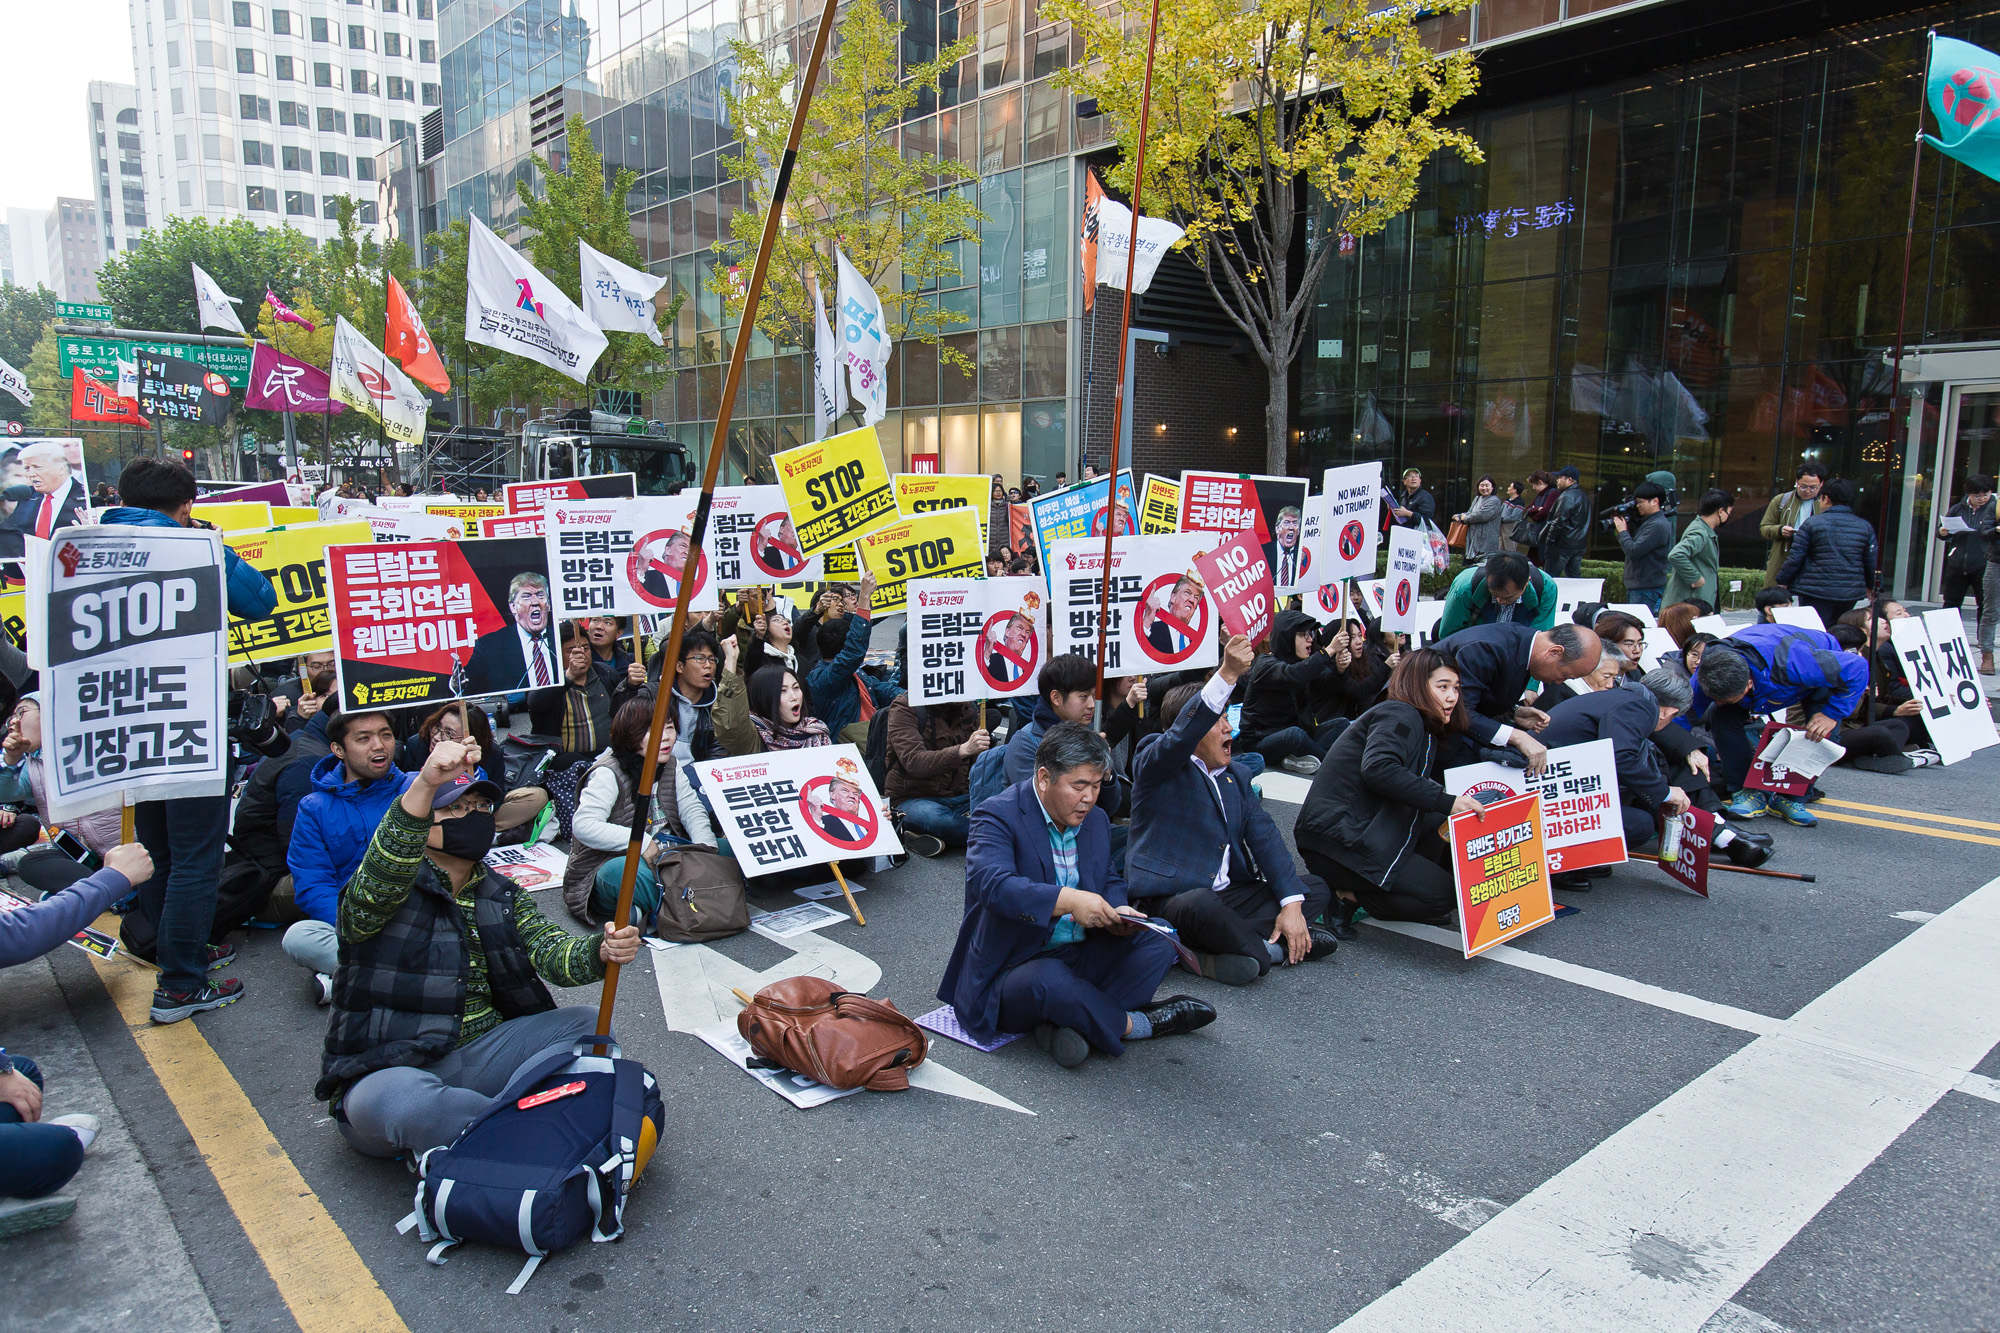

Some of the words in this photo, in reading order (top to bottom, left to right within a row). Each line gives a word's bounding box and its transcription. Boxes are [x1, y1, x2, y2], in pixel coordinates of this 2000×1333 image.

[67, 343, 94, 357] 종로
[68, 356, 96, 366] Jongno
[141, 358, 167, 378] 방미
[141, 379, 203, 402] 트럼프탄핵
[794, 455, 823, 475] 노동자연대
[805, 459, 866, 512] STOP
[1151, 484, 1176, 499] 한반도
[1191, 480, 1242, 505] 트럼프
[1338, 488, 1350, 501] NO
[1350, 484, 1370, 500] WAR!
[430, 509, 458, 517] 한반도
[458, 509, 476, 517] 군사
[478, 509, 495, 517] 긴장
[1037, 501, 1060, 517] 이주민
[1064, 494, 1082, 507] 여성
[1039, 510, 1070, 529] 성소수자
[1069, 502, 1091, 519] 차별의
[1147, 498, 1178, 524] 트럼
[1189, 505, 1256, 529] 국회연설
[1333, 504, 1345, 517] NO
[1345, 498, 1373, 515] TRUMP!
[568, 514, 612, 525] 노동자연대
[797, 518, 843, 549] 한반도
[844, 489, 894, 526] 긴장고조
[1043, 518, 1088, 542] 트럼프
[1304, 516, 1320, 527] AR!
[560, 530, 635, 555] 트럼프
[714, 537, 741, 558] 한
[877, 529, 910, 545] 노동자연대
[76, 551, 151, 569] 노동자연대
[236, 548, 263, 562] 연대
[885, 537, 955, 578] STOP
[1078, 558, 1122, 570] 노동자대
[1214, 545, 1249, 579] NO
[1397, 547, 1405, 556] NO
[1405, 548, 1417, 558] WAR!
[344, 550, 441, 585] 트럼프
[561, 558, 615, 583] 방한
[716, 560, 742, 581] 대
[1393, 560, 1402, 570] NO
[1401, 561, 1418, 574] TRUMP!
[1068, 575, 1144, 606] 트럼프
[1213, 559, 1267, 604] TRUMP
[349, 583, 474, 621] 국회연설
[563, 585, 616, 612] 반대
[929, 596, 965, 606] 노동자연대
[1239, 593, 1266, 625] NO
[71, 576, 198, 651] STOP
[921, 612, 984, 638] 트럼프
[1068, 608, 1122, 639] 방한
[352, 617, 479, 660] 웬말이냐
[1246, 612, 1269, 643] WAR
[922, 641, 965, 668] 방한
[77, 665, 188, 723] 한반도
[371, 684, 430, 703] 노동자연대
[922, 670, 965, 698] 반대
[62, 720, 210, 785] 긴장고조
[726, 768, 768, 781] 노동자연대
[1563, 774, 1602, 794] 막말!
[722, 779, 803, 811] 트럼프
[1476, 781, 1508, 794] TRUMP!
[1544, 793, 1611, 819] 국민에게
[735, 808, 794, 838] 방한
[1544, 814, 1602, 839] 과하라!
[1682, 811, 1697, 830] O
[748, 834, 808, 865] 반대
[1466, 832, 1495, 862] 한반도
[1496, 820, 1534, 850] 위기고조
[1483, 846, 1521, 877] 트럼프를
[1548, 852, 1564, 871] 당
[1669, 860, 1697, 883] WAR
[1469, 873, 1508, 907] 환영하지
[1508, 861, 1539, 890] 않는다!
[1496, 903, 1521, 931] 민중당
